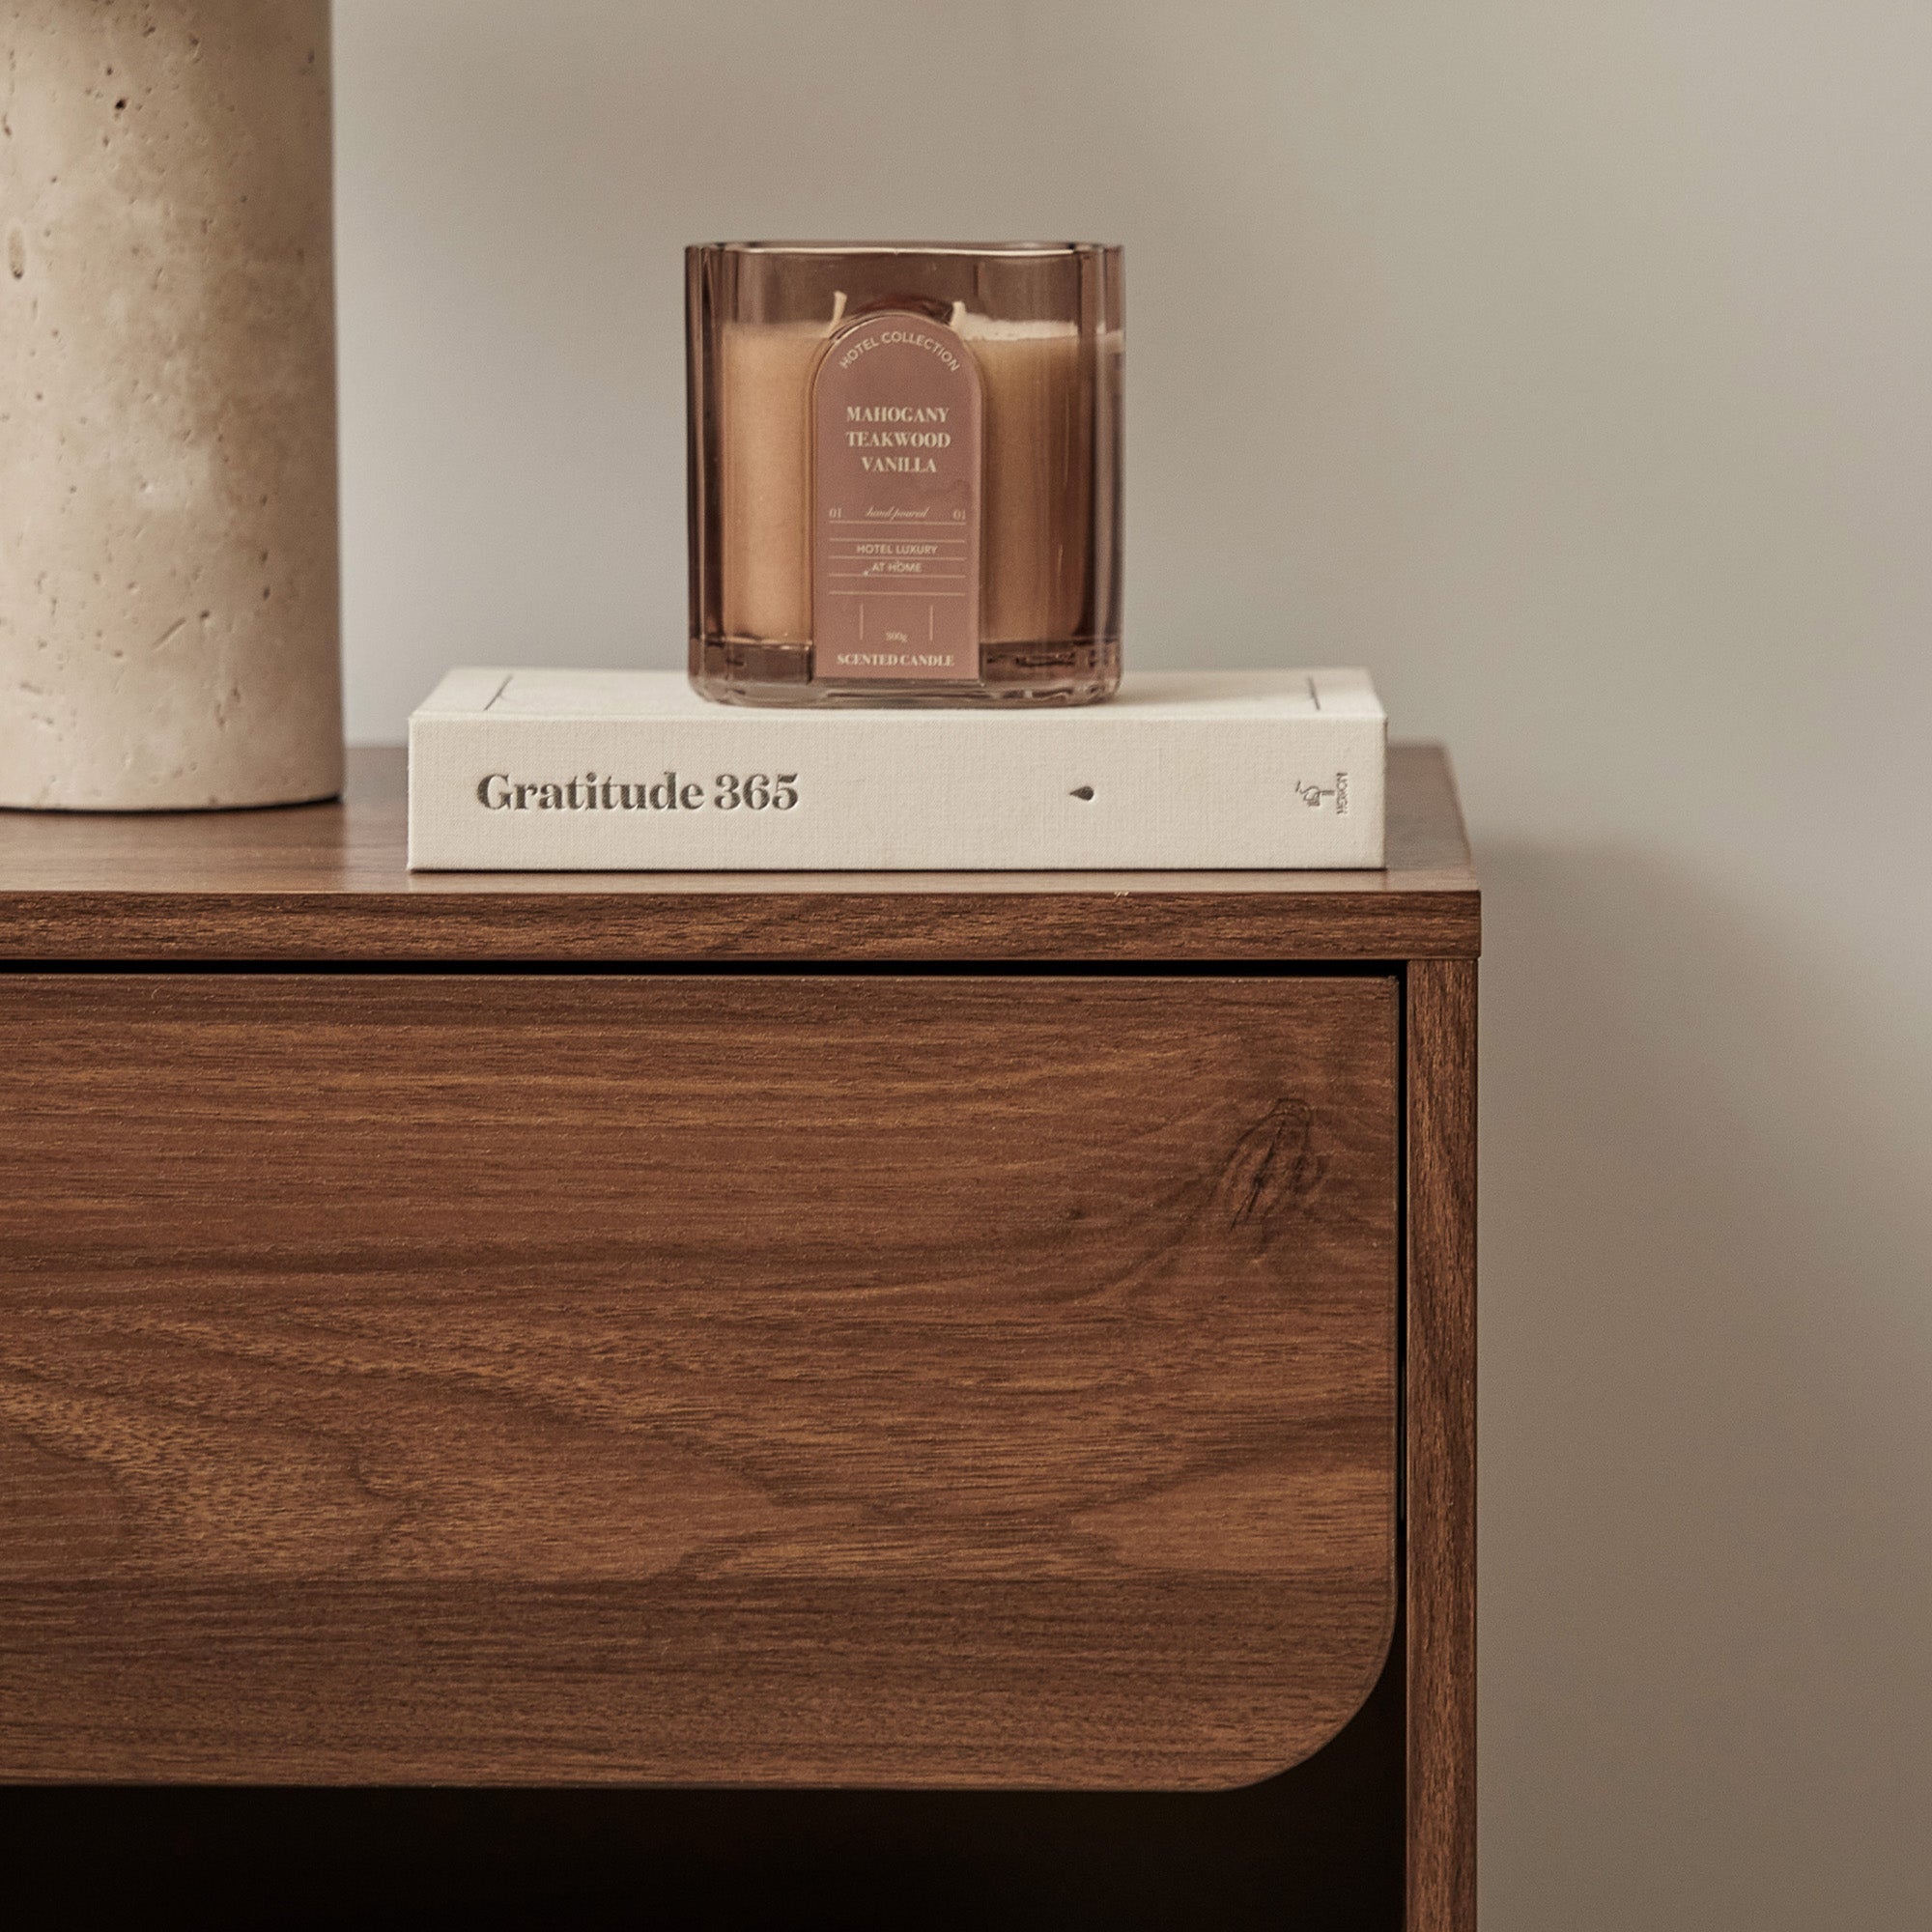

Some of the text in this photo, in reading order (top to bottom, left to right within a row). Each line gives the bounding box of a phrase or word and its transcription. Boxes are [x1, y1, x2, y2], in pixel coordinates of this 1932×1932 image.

[838, 330, 961, 373] HOTEL COLLECTION
[846, 406, 950, 423] MAHOGANY
[846, 431, 952, 448] TEAKWOOD
[861, 456, 937, 473] VANILLA
[828, 507, 842, 519] 01
[952, 508, 966, 521] 01
[857, 544, 938, 555] HOTEL LUXURY
[872, 561, 922, 573] AT HOME
[837, 653, 955, 668] SCENTED CANDLE
[476, 772, 800, 810] Gratitude 365
[1336, 772, 1349, 814] HERON
